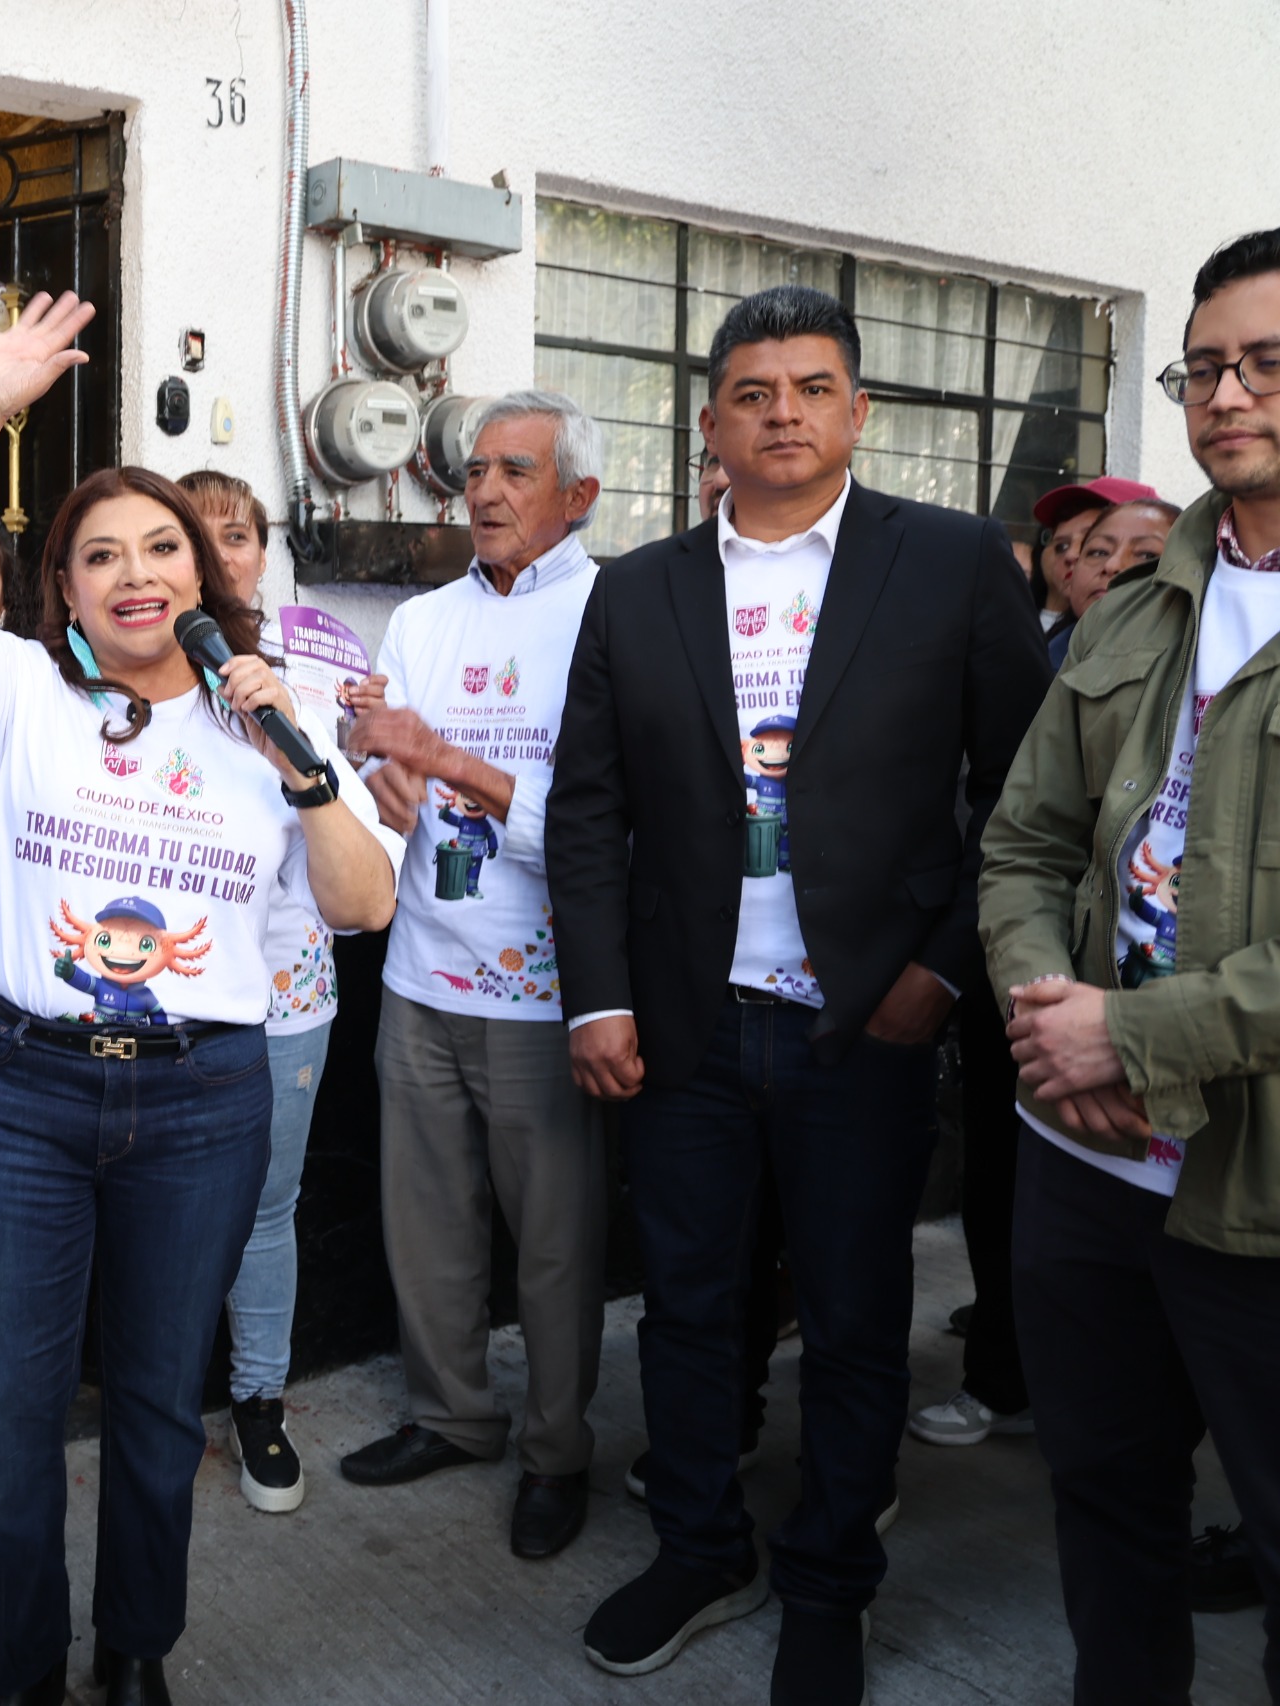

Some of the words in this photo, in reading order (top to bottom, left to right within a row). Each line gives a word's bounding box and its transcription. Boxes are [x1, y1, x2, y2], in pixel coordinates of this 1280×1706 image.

[205, 77, 246, 128] 36
[293, 626, 336, 646] TRANSFORMA
[289, 638, 309, 653] CADA
[343, 652, 352, 666] SU
[766, 647, 784, 658] DE
[446, 706, 483, 716] CIUDAD
[484, 707, 495, 715] DE
[496, 705, 526, 715] MÉXICO
[494, 727, 504, 741] TU
[506, 727, 553, 745] CIUDAD,
[488, 746, 499, 760] EN
[503, 746, 517, 760] SU
[519, 745, 551, 761] LUGA
[76, 786, 135, 810] CIUDAD
[138, 800, 158, 815] DE
[163, 804, 224, 825] MÉXICO
[73, 803, 109, 820] CAPITAL
[111, 812, 124, 822] DE
[125, 816, 135, 825] LA
[137, 817, 223, 839] TRANSFORMACIÓN
[26, 810, 150, 857] TRANSFORMA
[158, 838, 182, 862] TU
[188, 843, 256, 881] CIUDAD,
[15, 837, 52, 867] CADA
[59, 848, 142, 885] RESIDUO
[148, 866, 173, 889] EN
[179, 871, 205, 894] SU
